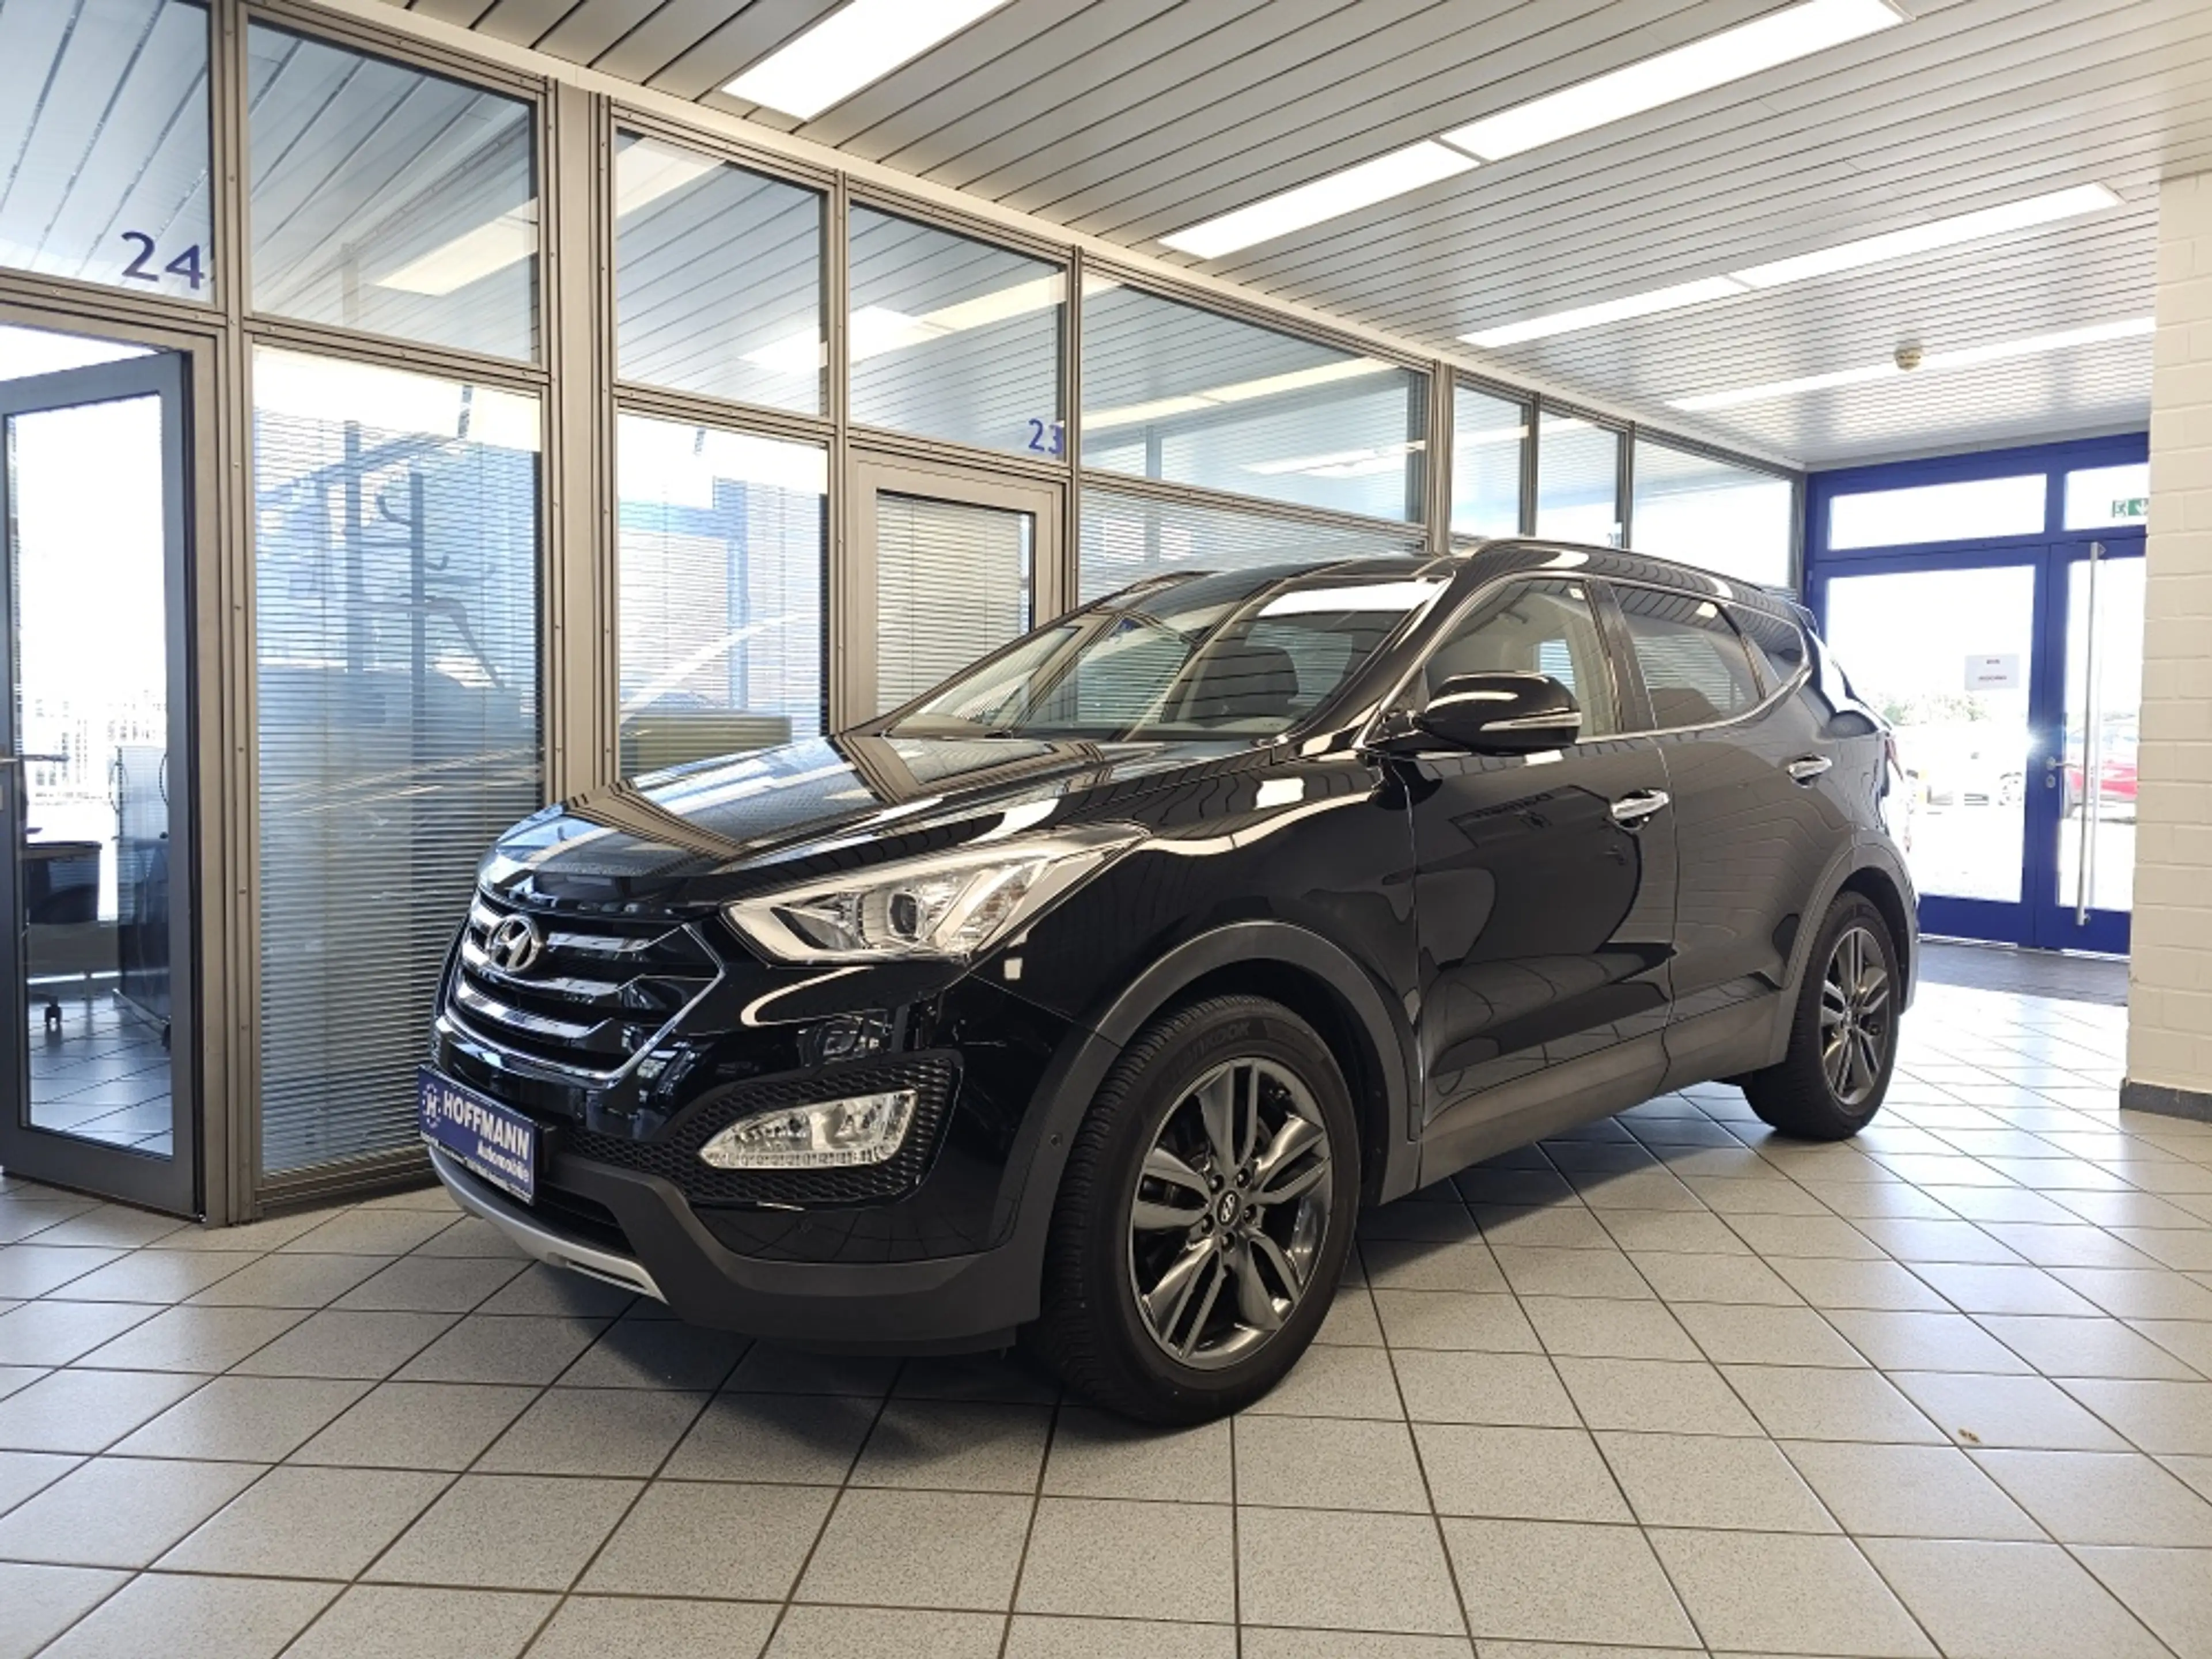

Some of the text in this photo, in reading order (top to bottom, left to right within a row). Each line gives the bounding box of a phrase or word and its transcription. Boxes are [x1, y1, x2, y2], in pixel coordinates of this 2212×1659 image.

[122, 231, 204, 290] 24
[1029, 418, 1063, 454] 23
[443, 1090, 530, 1160] HOFFMANN
